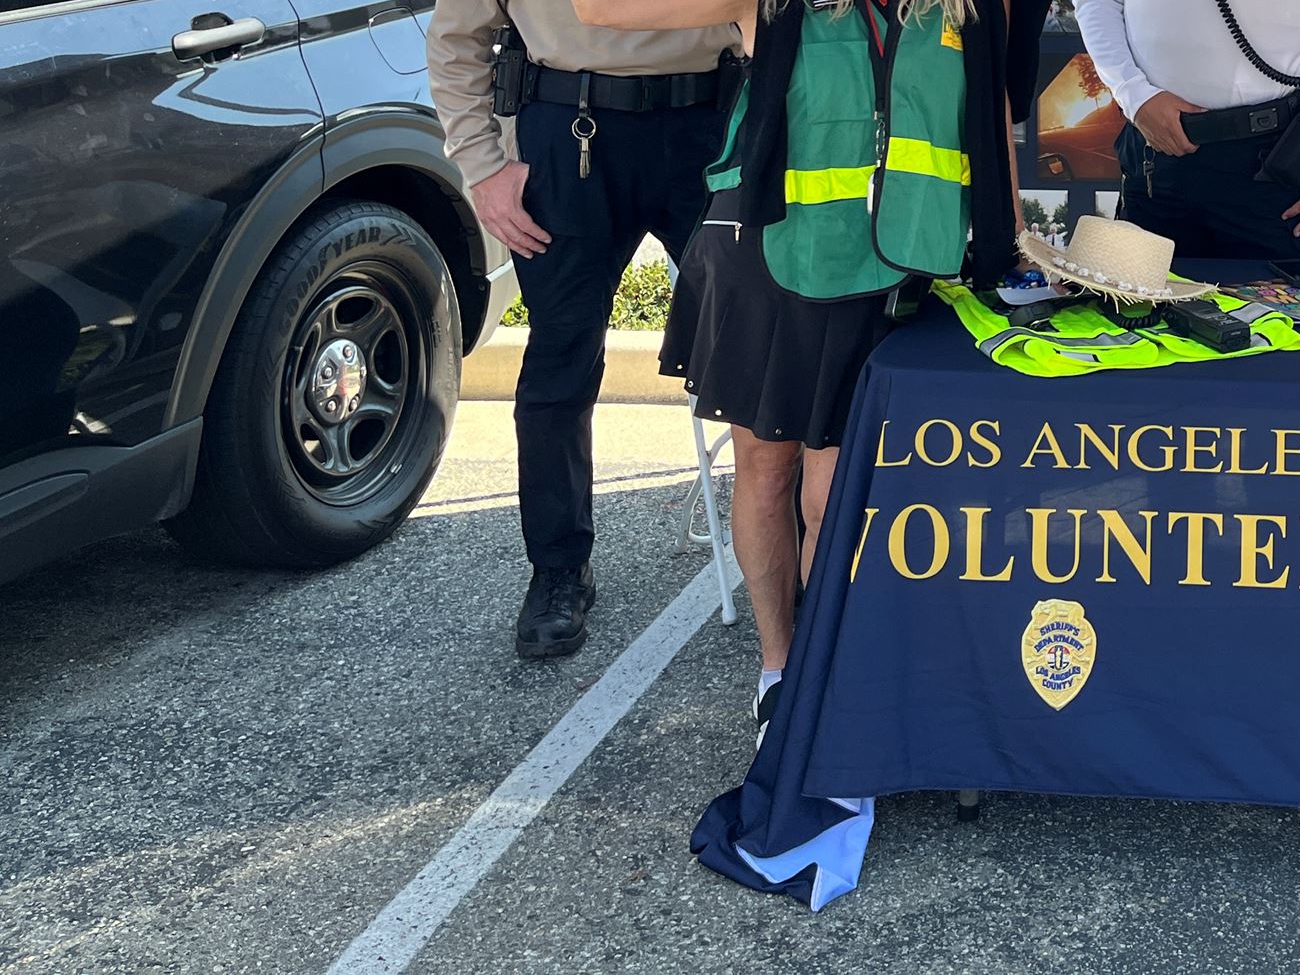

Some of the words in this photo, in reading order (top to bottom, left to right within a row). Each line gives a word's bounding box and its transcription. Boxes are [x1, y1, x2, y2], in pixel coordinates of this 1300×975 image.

[873, 418, 1002, 468] LOS
[1040, 621, 1080, 637] SHERIFF'S
[1034, 634, 1084, 653] DEPARTMENT
[1036, 666, 1048, 677] LOS
[1042, 678, 1073, 690] COUNTY
